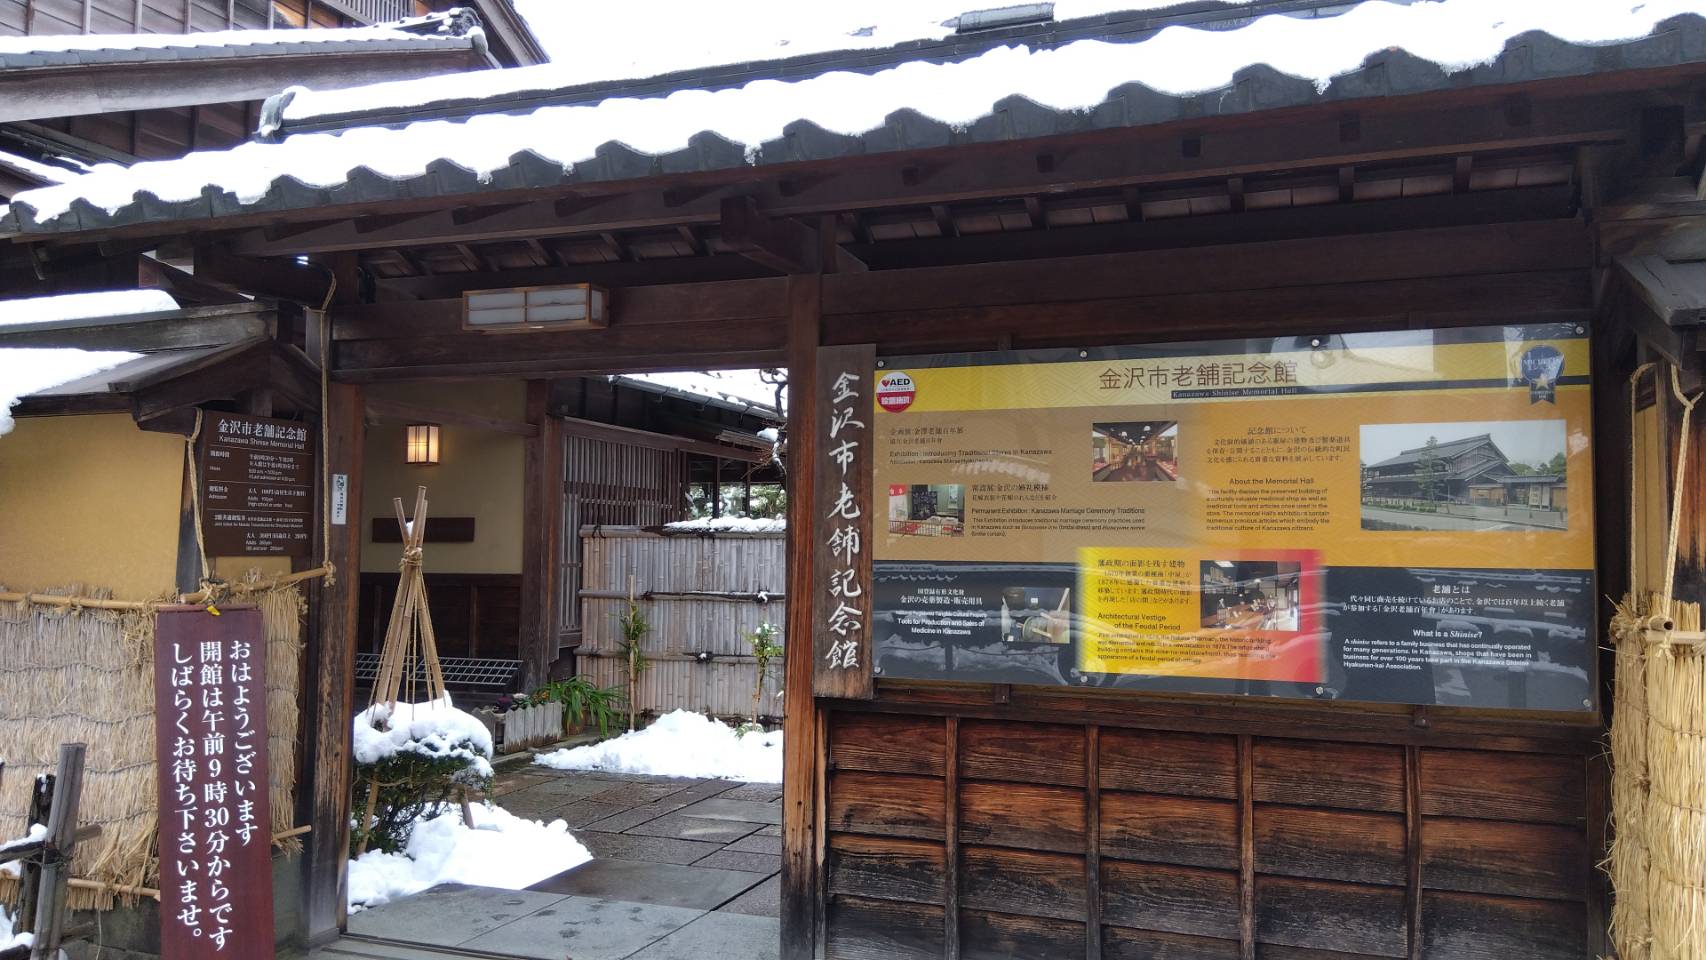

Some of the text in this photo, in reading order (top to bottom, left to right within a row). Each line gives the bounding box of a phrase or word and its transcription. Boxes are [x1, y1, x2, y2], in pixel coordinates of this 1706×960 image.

[1099, 360, 1298, 389] 金沢市老舗記念館
[1173, 386, 1297, 399] Kanazawa Shinise Memorial Hall
[218, 419, 307, 442] 金沢市老舗記念館
[1248, 426, 1306, 435] 記念館について
[295, 442, 305, 450] Hall
[826, 372, 864, 669] 金沢市老舗記念館
[1433, 584, 1471, 594] 老舗とは
[1098, 612, 1166, 623] Architectural Vestige
[1123, 622, 1133, 630] the
[1160, 623, 1181, 631] Period
[1413, 629, 1482, 639] What is a Shinise?
[1353, 646, 1370, 654] many
[1372, 647, 1410, 655] generations.
[230, 640, 258, 846] おはようございます
[171, 642, 202, 937] しばらくお待ち下さいませ。
[200, 641, 233, 951] 開館は午前9時30分からです
